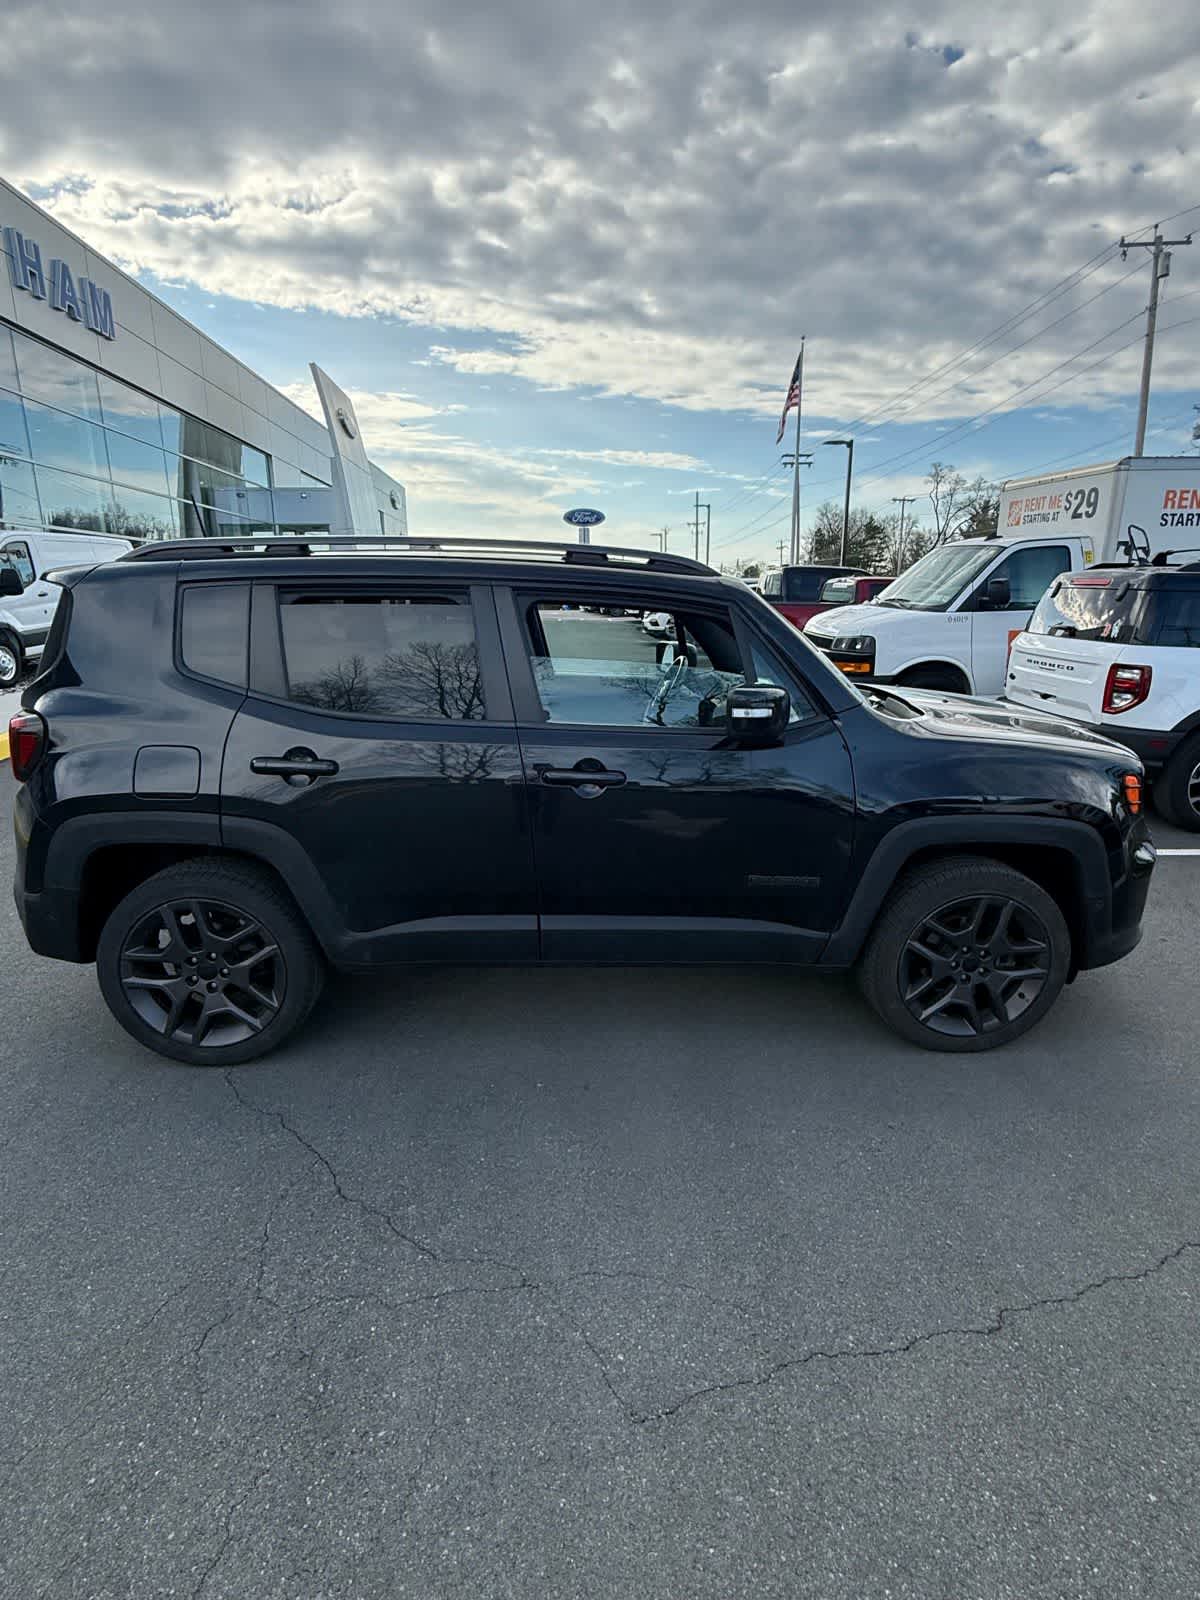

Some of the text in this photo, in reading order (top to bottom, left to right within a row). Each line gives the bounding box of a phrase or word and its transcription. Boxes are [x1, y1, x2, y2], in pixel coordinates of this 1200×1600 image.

[1024, 494, 1063, 512] RENT ME
[1064, 487, 1099, 520] $29
[1022, 512, 1051, 525] STARTING
[1051, 511, 1061, 522] AT
[1027, 658, 1075, 671] BRONCO
